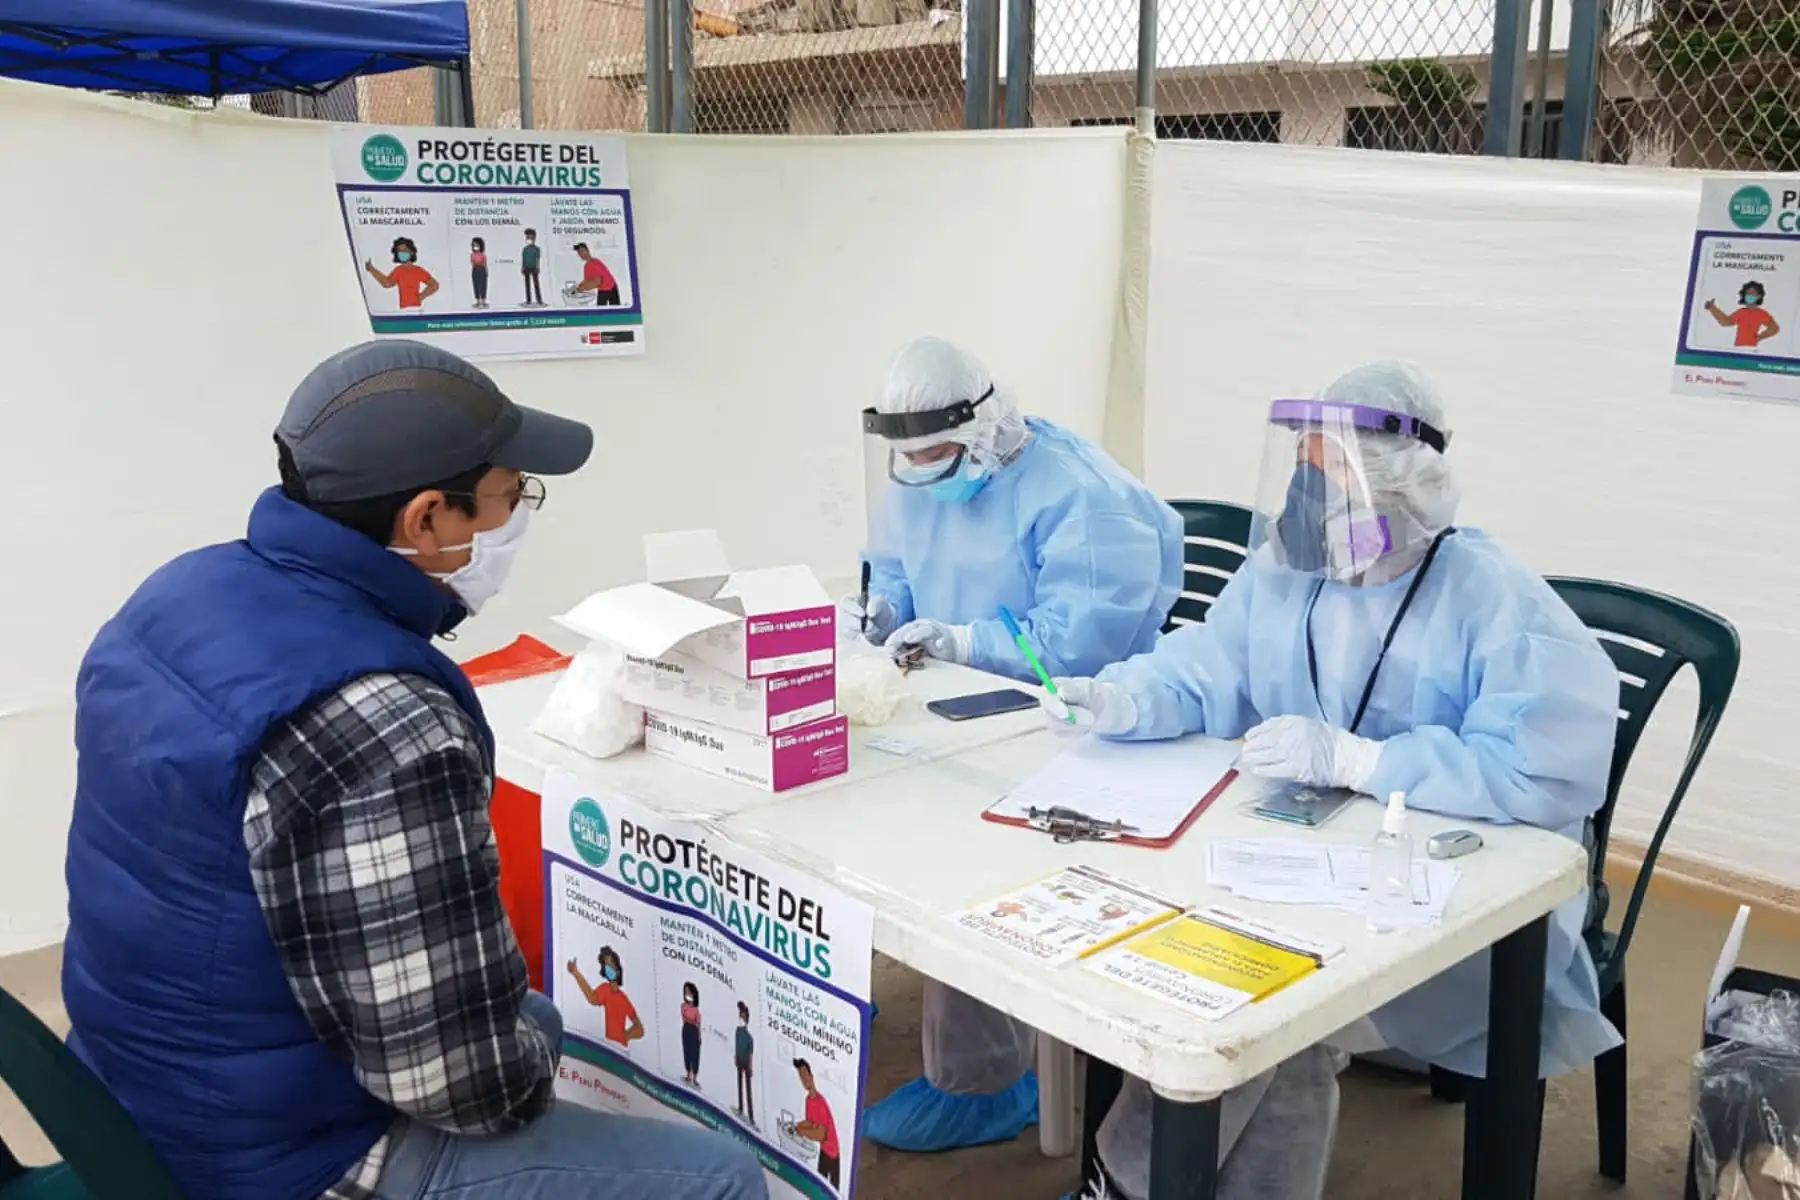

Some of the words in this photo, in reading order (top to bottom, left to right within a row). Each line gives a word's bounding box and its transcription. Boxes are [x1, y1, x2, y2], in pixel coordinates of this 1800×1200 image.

[417, 136, 551, 162] PROTÉGETE
[559, 145, 600, 164] DEL
[416, 162, 602, 187] CORONAVIRUS
[356, 206, 430, 215] CORRECTAMENTE
[1714, 251, 1785, 262] CORRECTAMENTE
[580, 826, 608, 850] SALUD
[620, 818, 771, 911] PROTÉGETE
[778, 887, 830, 941] DEL
[566, 901, 577, 912] LA
[566, 888, 634, 929] CORRECTAMENTE
[619, 852, 832, 978] CORONAVIRUS
[661, 931, 675, 945] DE
[677, 936, 724, 966] DISTANCIA
[662, 946, 685, 962] CON
[687, 954, 705, 971] LOS
[712, 937, 738, 962] METRO
[767, 1001, 772, 1012] Y
[802, 989, 820, 1006] LAS
[766, 986, 802, 1013] MANOS
[804, 1006, 827, 1025] CON
[829, 1017, 857, 1044] AGUA
[768, 1016, 779, 1030] 20
